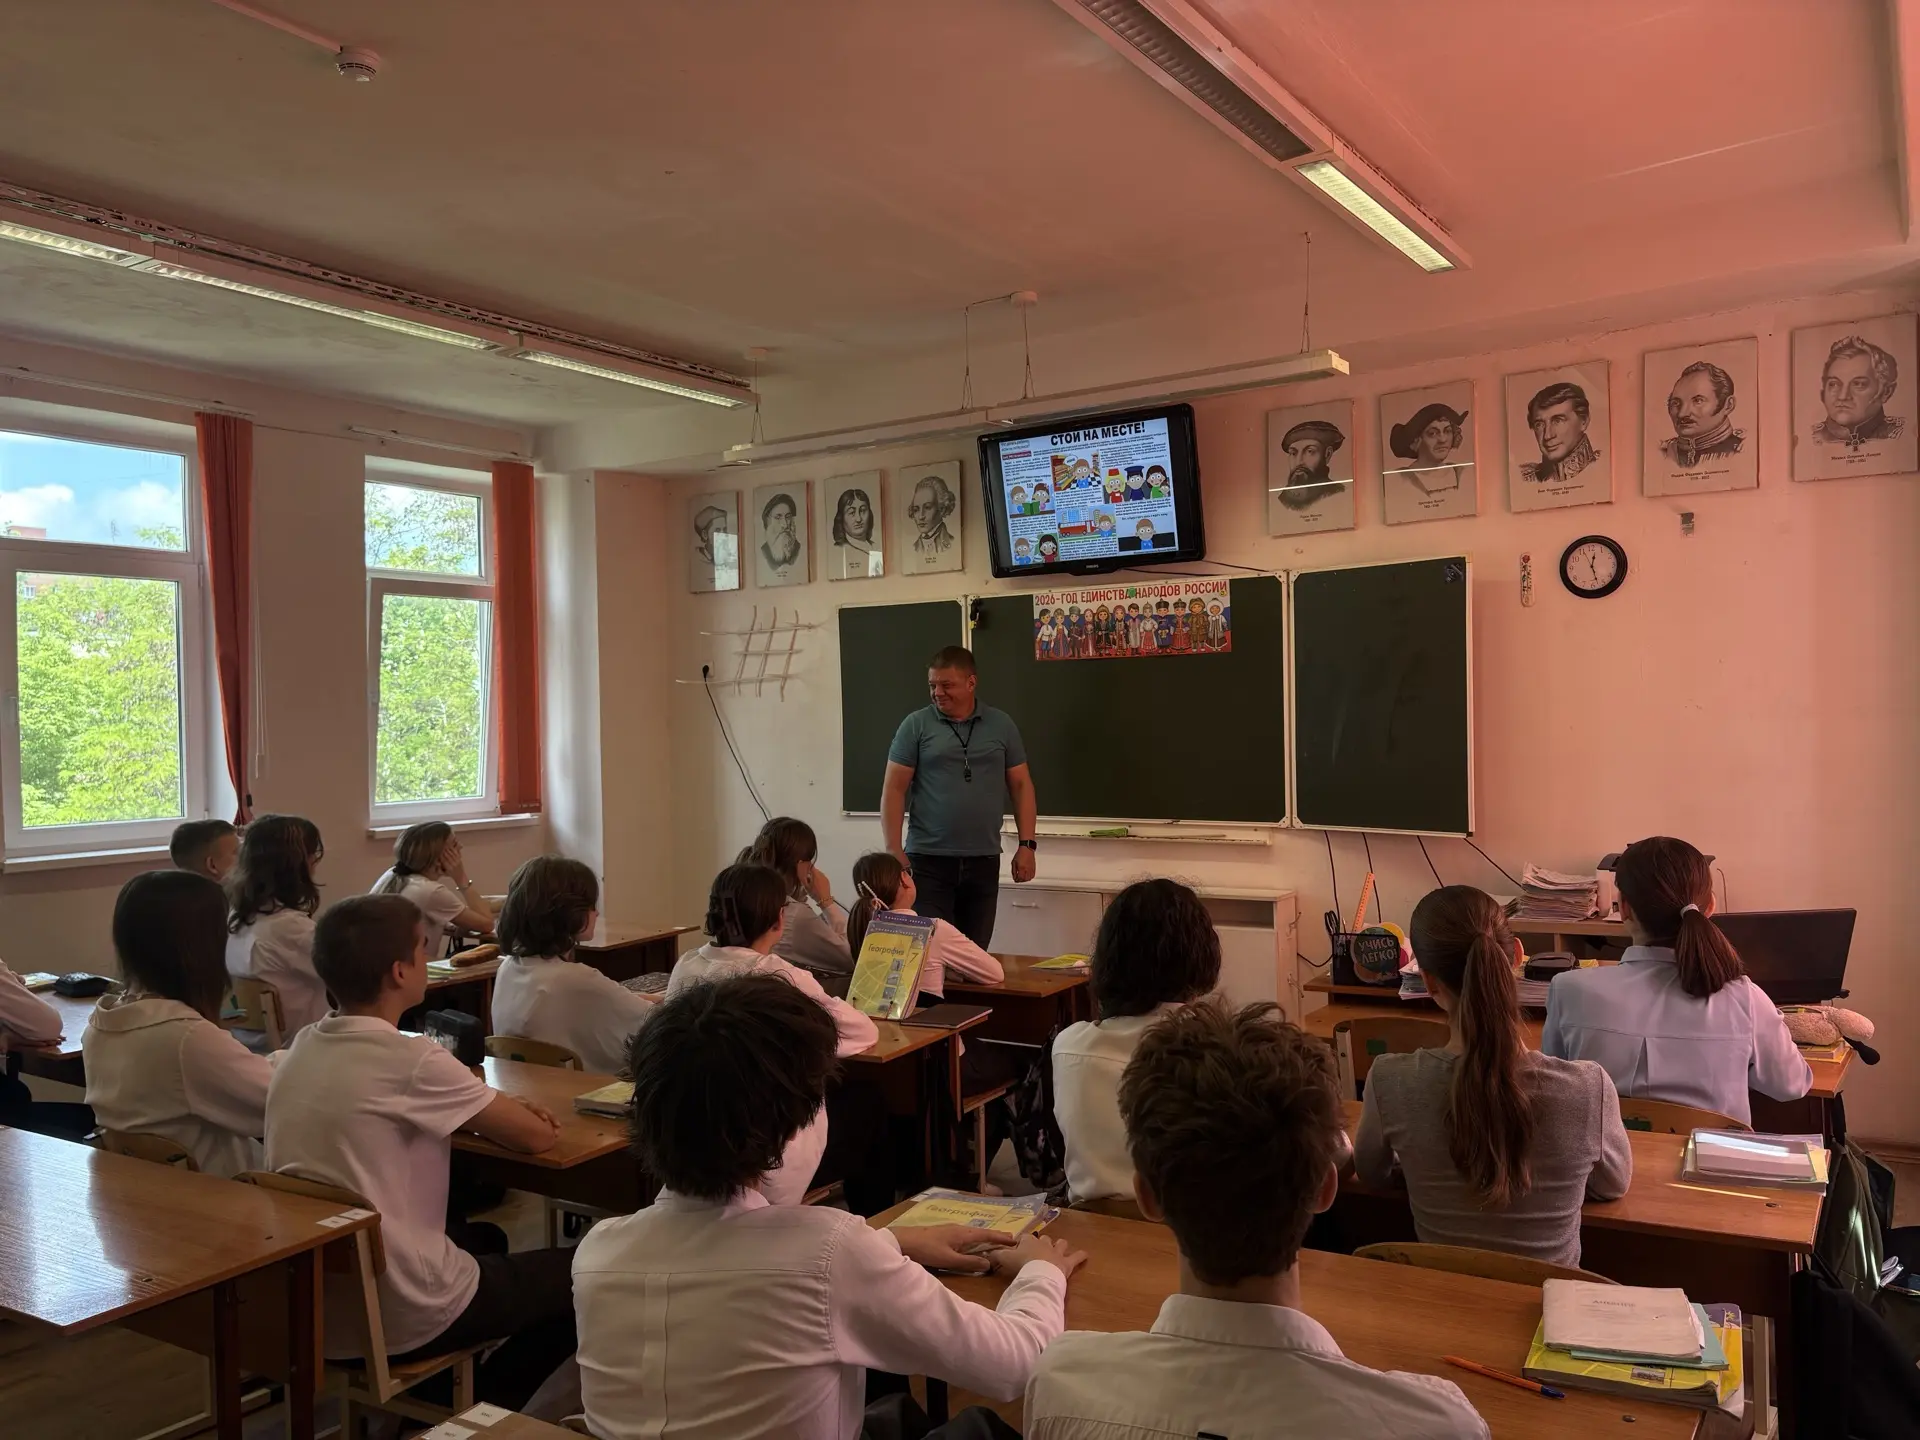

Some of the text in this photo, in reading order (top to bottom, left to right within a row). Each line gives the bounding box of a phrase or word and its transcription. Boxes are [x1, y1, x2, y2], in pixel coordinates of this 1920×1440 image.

[1083, 429, 1099, 441] НА
[1101, 421, 1145, 438] МЕСТЕ!
[1588, 544, 1596, 552] 12
[1034, 592, 1079, 606] 2026-ГОД
[1134, 584, 1180, 599] НАРОДОВ
[1184, 580, 1227, 595] РОССИИ
[868, 944, 905, 957] География
[1358, 937, 1394, 951] УЧИСЬ
[908, 952, 919, 965] 7
[1362, 949, 1397, 963] ЛЕГКО!
[1005, 1216, 1025, 1224] 7
